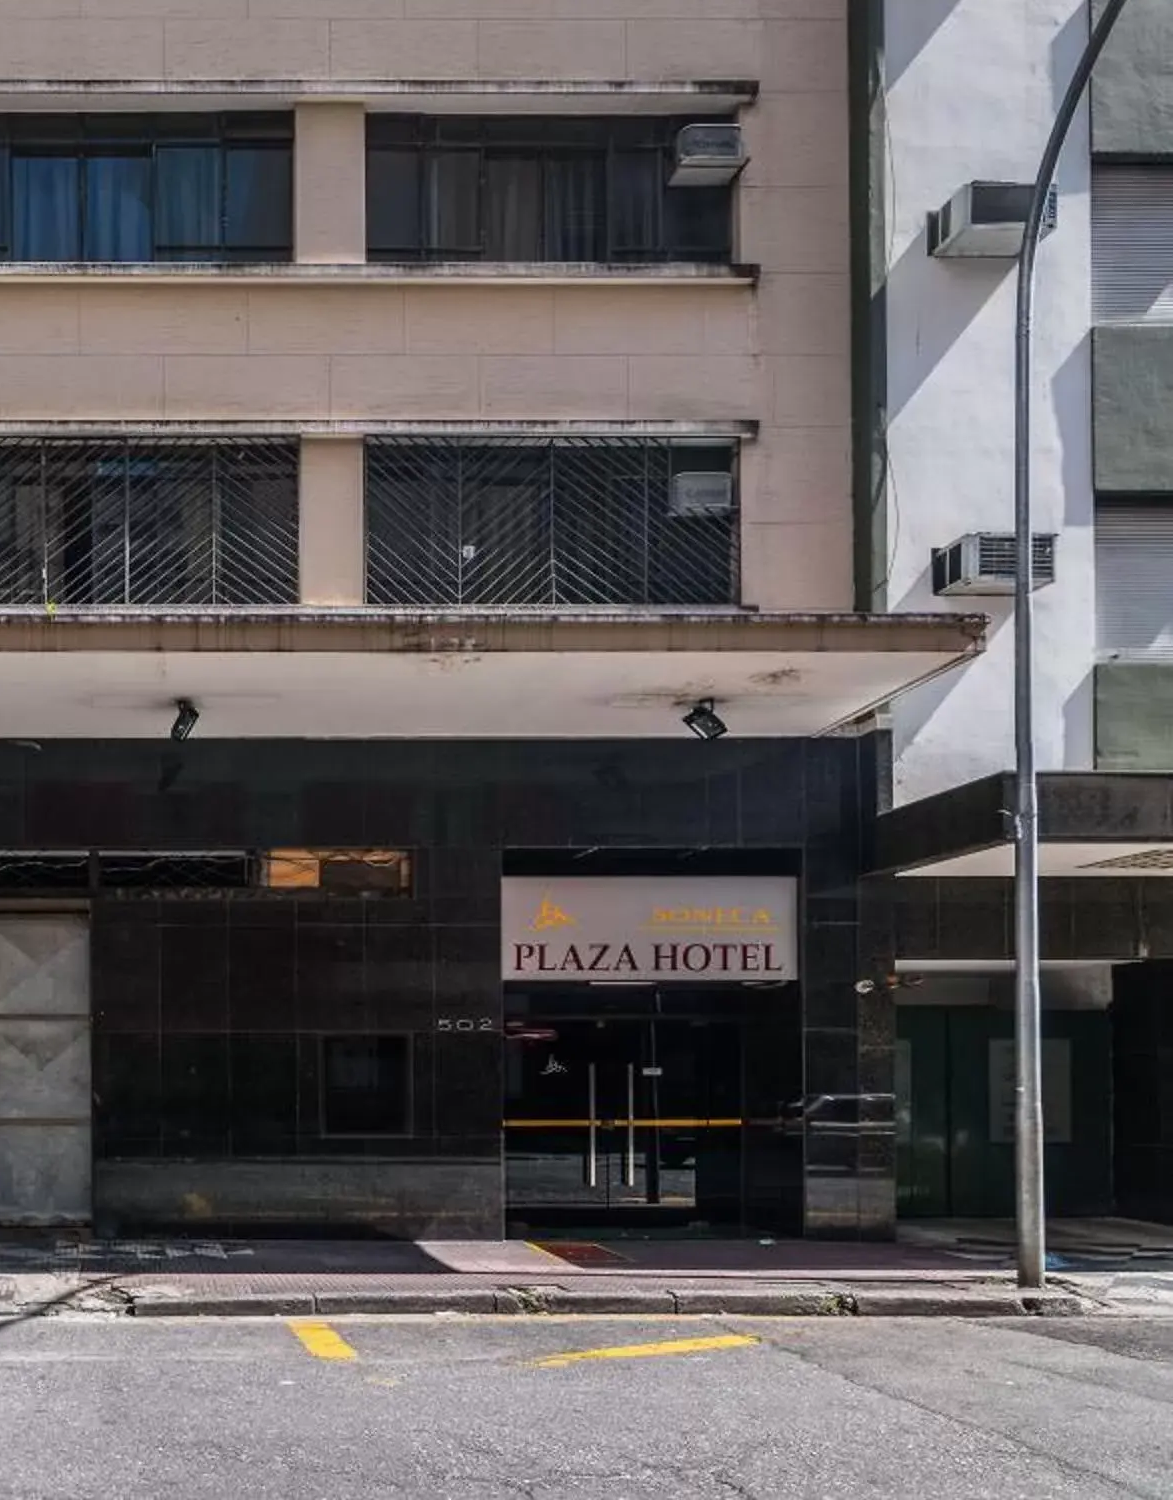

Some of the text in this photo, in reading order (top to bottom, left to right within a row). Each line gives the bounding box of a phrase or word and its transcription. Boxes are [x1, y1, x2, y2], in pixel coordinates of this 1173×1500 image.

[513, 942, 783, 972] PLAZA HOTEL
[438, 1018, 492, 1031] 502
